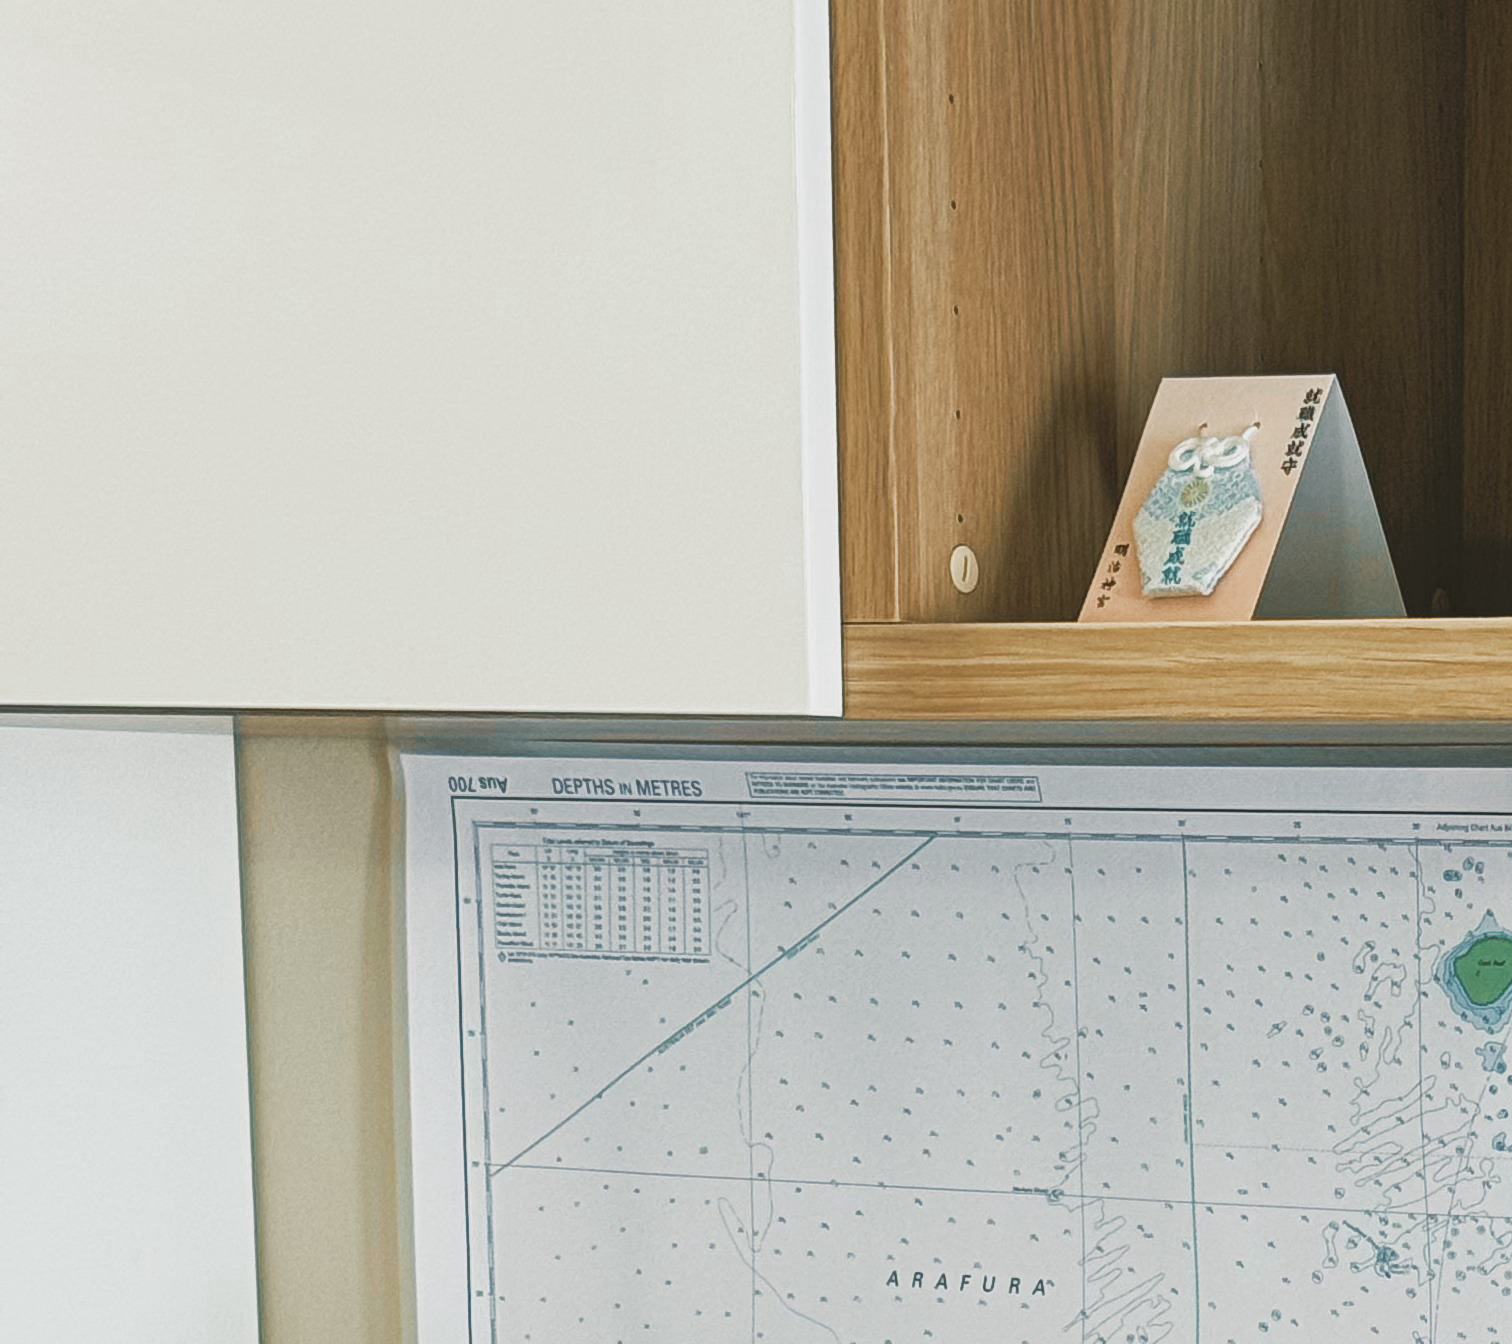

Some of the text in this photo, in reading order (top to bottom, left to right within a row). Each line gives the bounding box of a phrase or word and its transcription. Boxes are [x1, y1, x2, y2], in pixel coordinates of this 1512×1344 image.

[449, 777, 508, 793] Aus 700
[552, 777, 615, 796] DEPTHS
[635, 779, 703, 797] METRES
[886, 1270, 1046, 1297] ARAFURA
